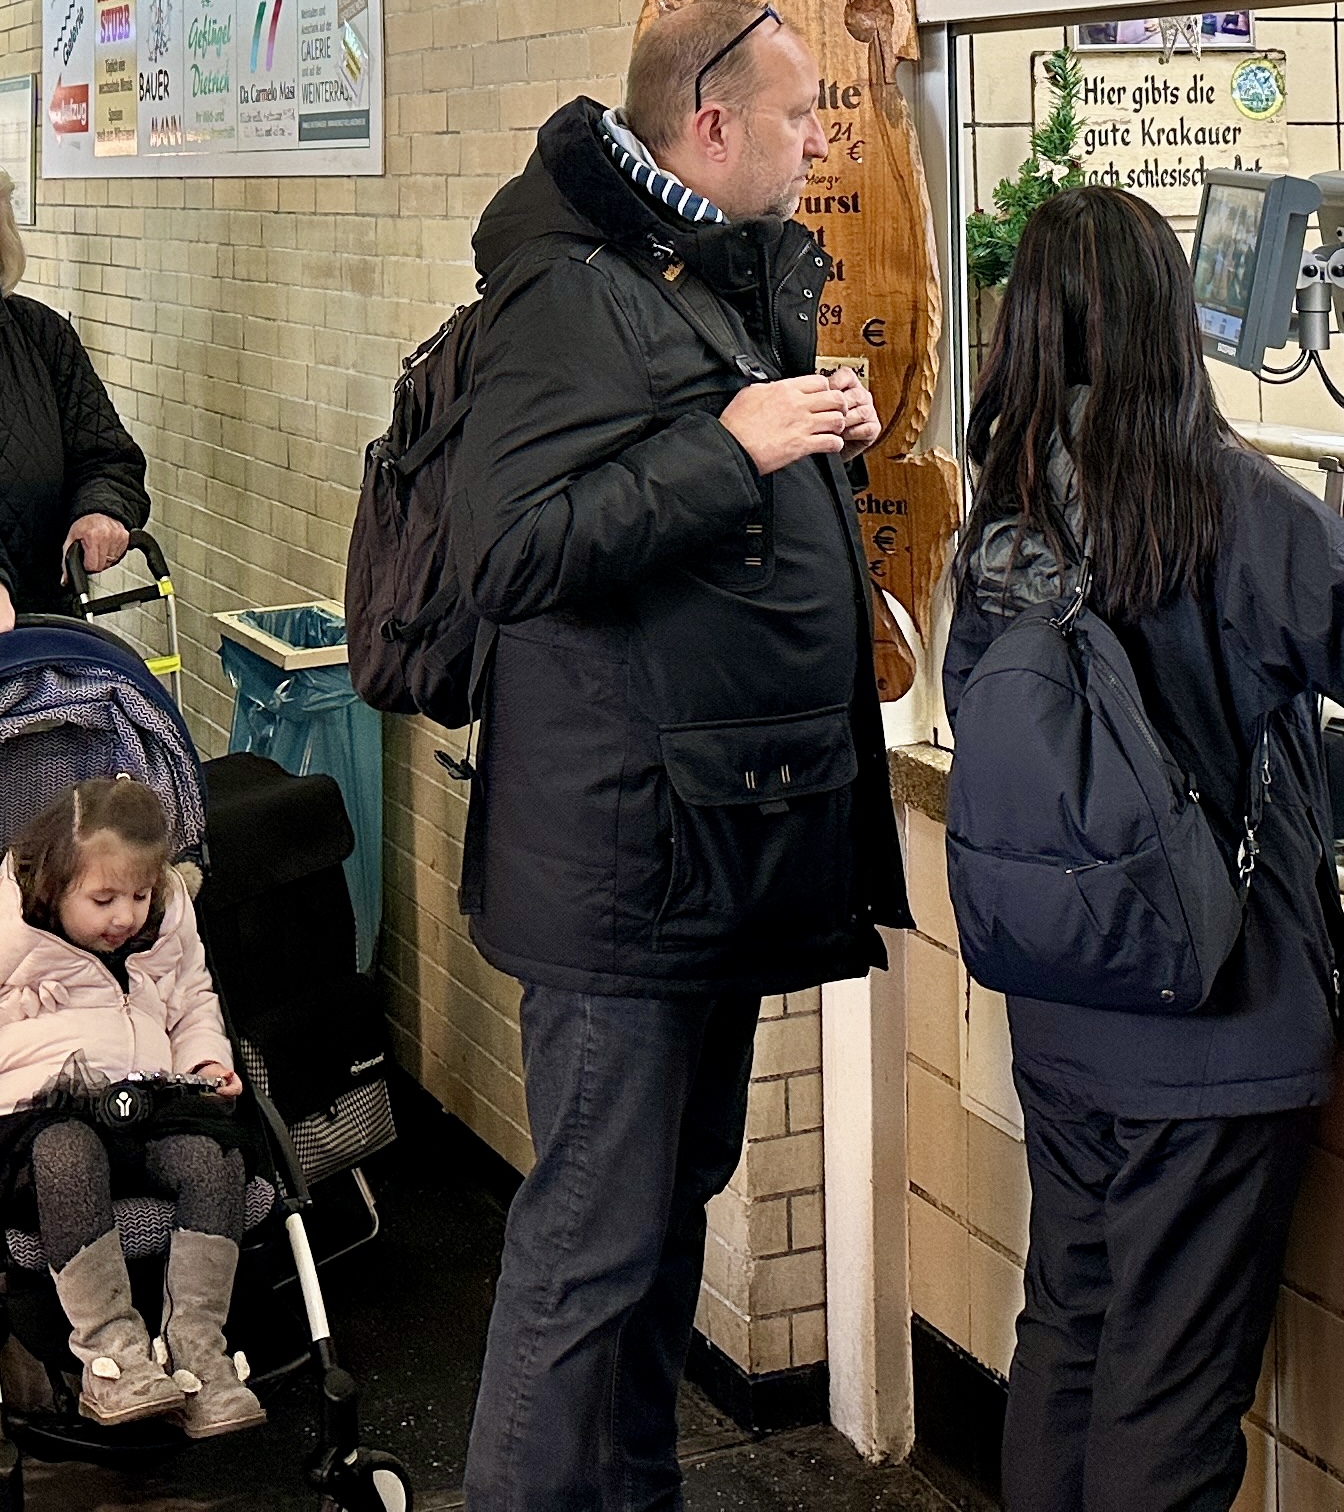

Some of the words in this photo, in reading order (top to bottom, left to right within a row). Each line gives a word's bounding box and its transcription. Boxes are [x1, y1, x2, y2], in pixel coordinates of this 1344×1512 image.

[63, 5, 84, 66] Galerie
[100, 4, 130, 44] STUBB
[188, 13, 232, 59] Geflügel
[301, 36, 331, 62] GALERIE
[139, 69, 170, 102] BAUER
[190, 58, 230, 98] Dietrich
[250, 81, 278, 103] Carmelo
[1083, 76, 1127, 105] Hier
[1132, 74, 1180, 113] gibts
[1186, 74, 1215, 105] die
[1084, 123, 1131, 155] gute
[1141, 116, 1242, 147] Krakauer
